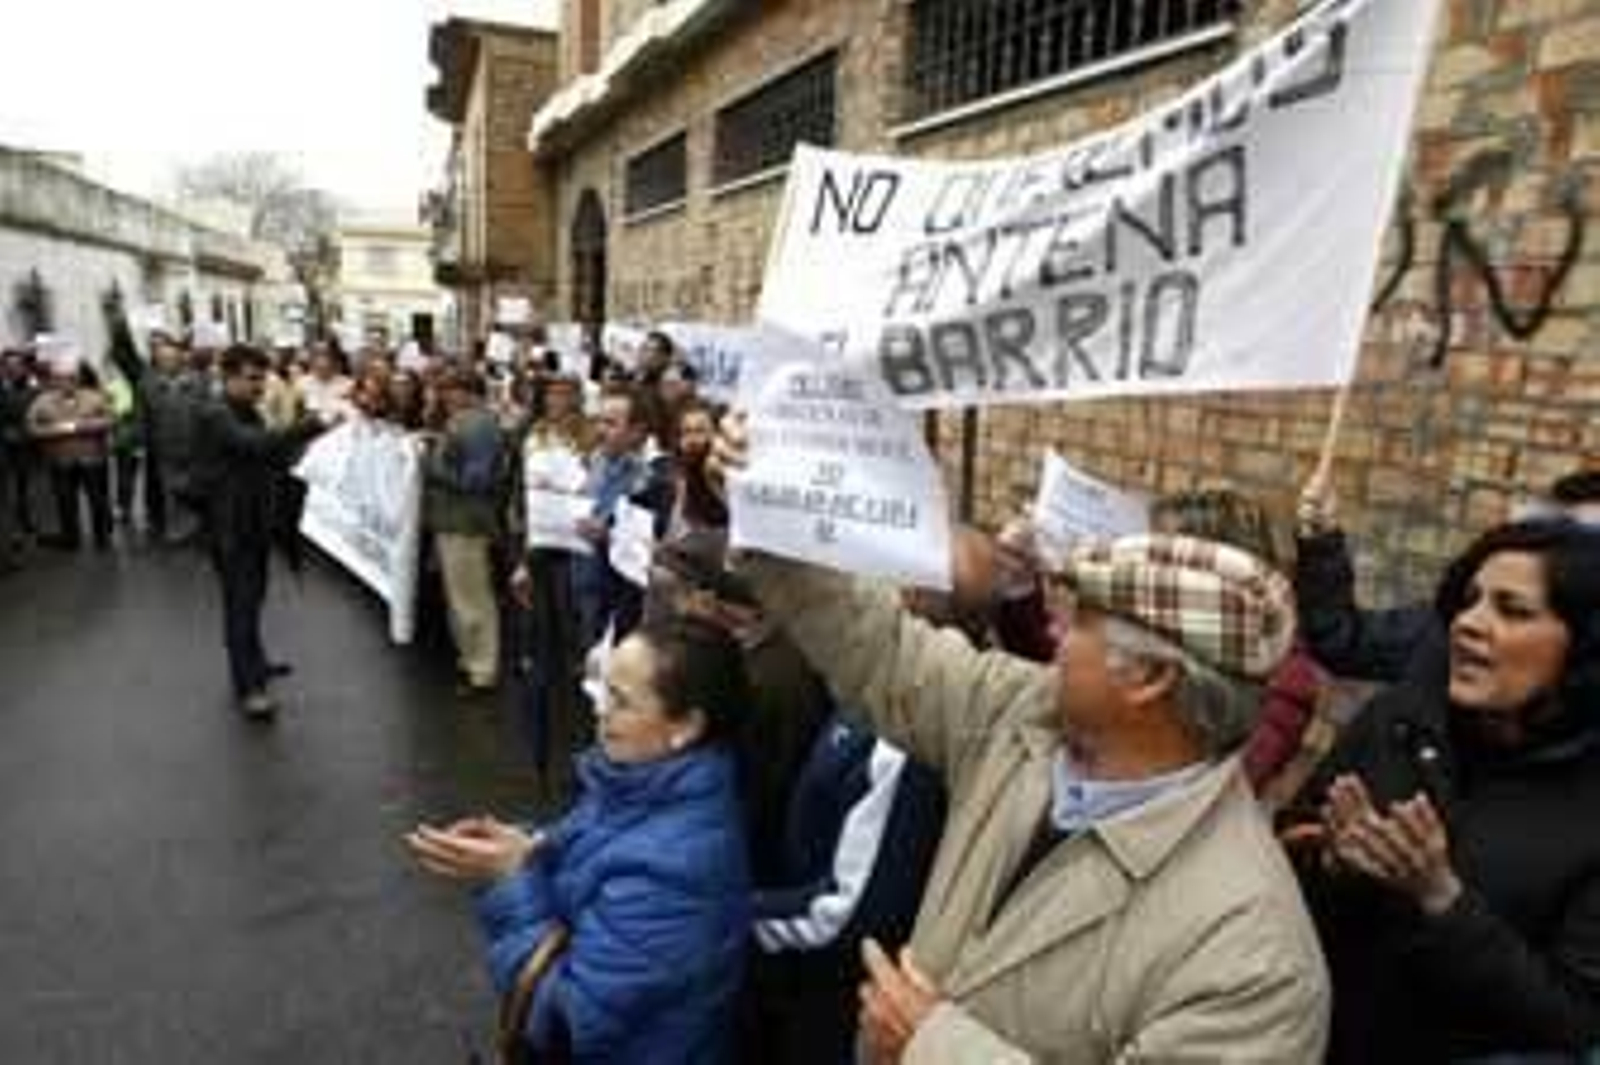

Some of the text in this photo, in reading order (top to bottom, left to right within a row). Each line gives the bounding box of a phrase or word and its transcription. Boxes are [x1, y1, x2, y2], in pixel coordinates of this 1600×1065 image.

[810, 168, 899, 234] NO
[884, 146, 1246, 318] ANTENA
[878, 269, 1200, 395] BARRIO
